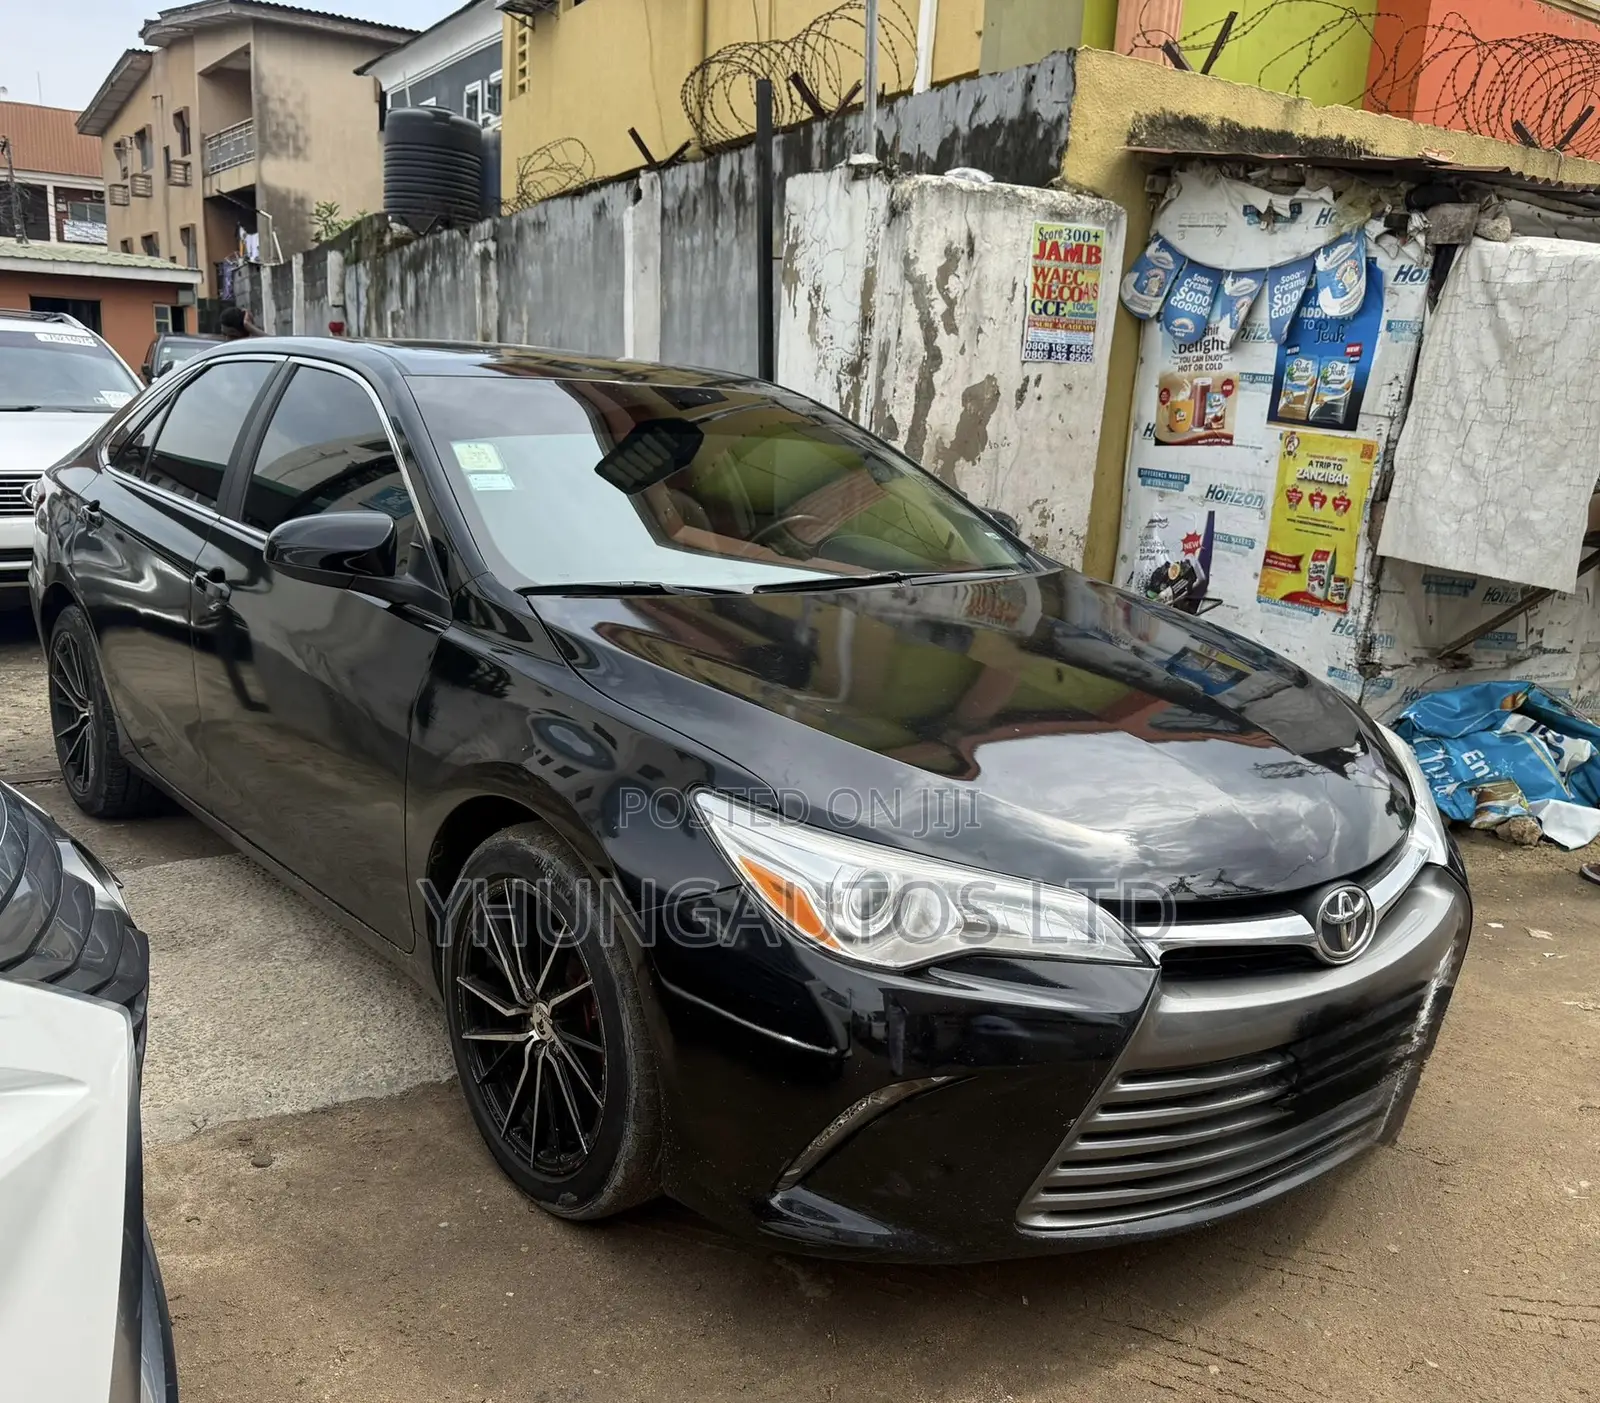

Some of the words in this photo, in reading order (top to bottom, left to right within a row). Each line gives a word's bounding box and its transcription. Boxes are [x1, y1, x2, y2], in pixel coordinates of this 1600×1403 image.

[1038, 226, 1064, 242] Score
[1064, 228, 1100, 243] 300+
[1032, 239, 1102, 265] JAMB
[1032, 265, 1085, 287] WAEC
[1032, 283, 1083, 302] NECO
[1031, 299, 1067, 317] GCE
[1303, 319, 1316, 330] TO
[1026, 341, 1050, 351] 0806
[1051, 343, 1068, 353] 162
[1070, 344, 1093, 355] 4556
[1178, 337, 1225, 355] Delight
[1025, 350, 1049, 360] 0805
[1051, 351, 1067, 361] 542
[1069, 353, 1092, 363] 9502
[1179, 356, 1191, 364] YOU
[1191, 355, 1204, 363] CAN
[1205, 354, 1223, 362] ENJOY
[1178, 364, 1192, 373] HOT
[1193, 364, 1204, 372] OR
[1205, 362, 1223, 371] COLD
[1308, 460, 1314, 468] A
[1315, 461, 1331, 470] TRIP
[1332, 463, 1343, 472] TO
[1140, 469, 1168, 479] DIFFERENCE
[1168, 473, 1188, 482] MAKERS
[1296, 467, 1350, 487] ZANZIBAR
[1205, 484, 1265, 508] Horizon
